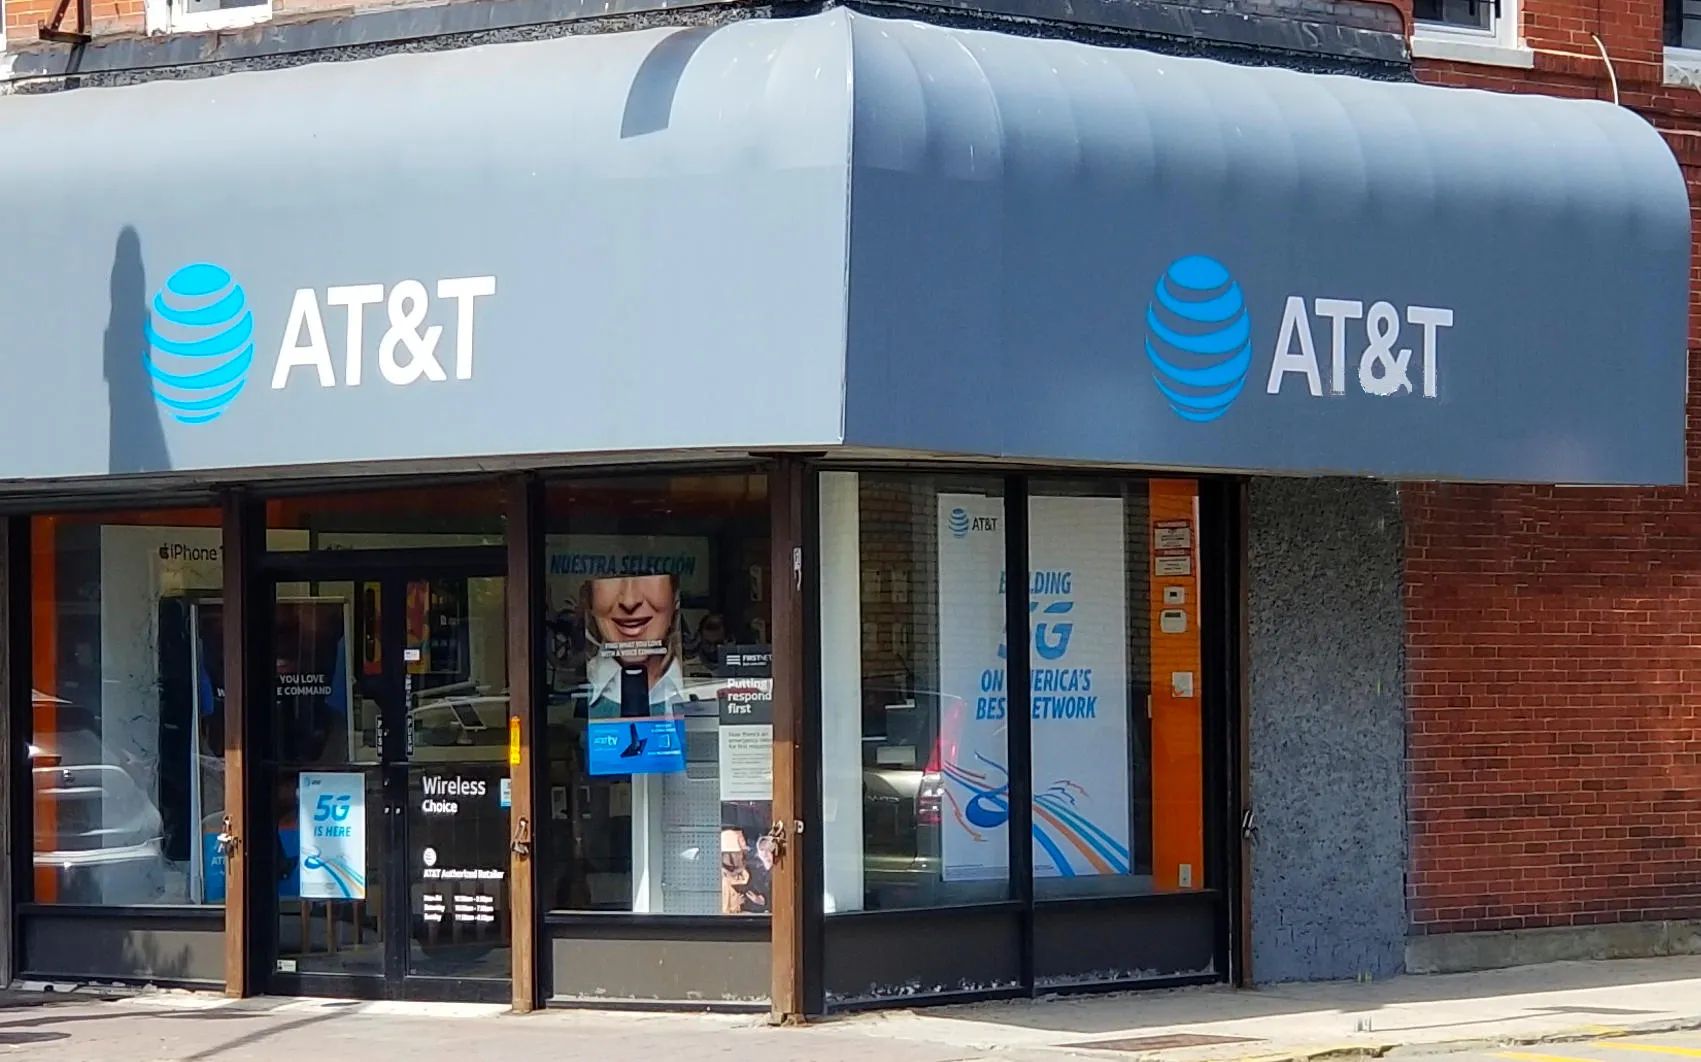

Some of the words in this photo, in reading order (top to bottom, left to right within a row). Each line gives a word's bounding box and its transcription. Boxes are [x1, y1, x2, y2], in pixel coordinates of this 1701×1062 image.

[271, 275, 496, 389] AT&T
[1266, 296, 1454, 398] AT&T
[972, 517, 997, 531] AT&T
[171, 544, 217, 561] iPhone
[551, 554, 616, 574] NUESTRA
[620, 552, 696, 576] SELECCIÓN
[280, 674, 299, 684] YOU
[301, 674, 325, 684] LOVE
[728, 678, 768, 693] Putting
[981, 669, 1004, 692] ON
[284, 686, 332, 696] COMMAND
[728, 703, 752, 714] first
[422, 775, 486, 795] Wireless
[313, 794, 351, 822] 5G
[422, 799, 458, 813] Choice
[313, 826, 323, 837] IS
[326, 826, 352, 837] HERE
